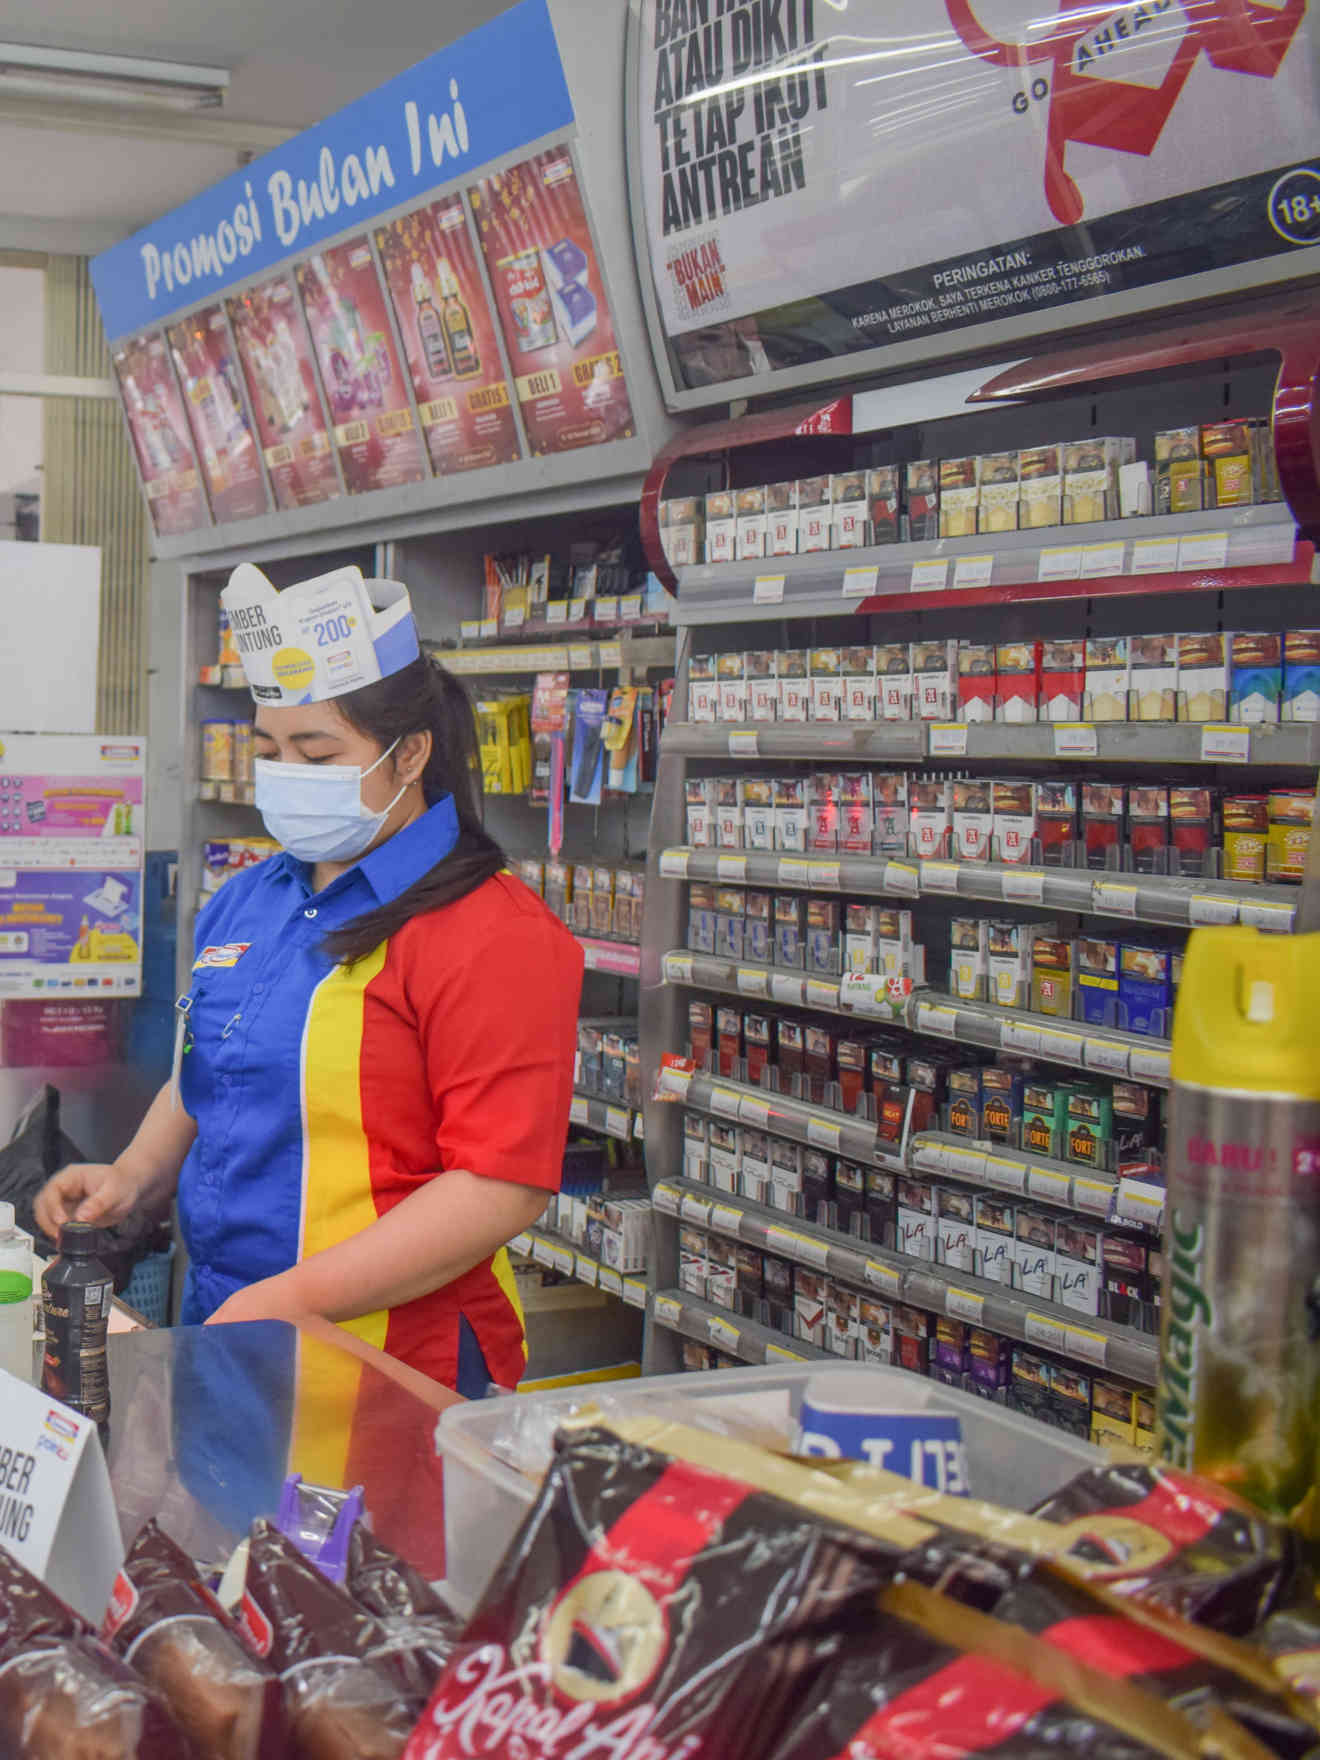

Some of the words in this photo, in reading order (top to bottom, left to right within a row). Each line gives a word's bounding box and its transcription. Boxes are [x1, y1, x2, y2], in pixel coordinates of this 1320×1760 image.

[655, 20, 723, 112] ATAU
[1012, 77, 1049, 114] GO
[654, 78, 746, 172] TETAP
[752, 44, 828, 136] IKUT
[140, 180, 262, 300] Promosi
[267, 145, 396, 247] Bulan
[404, 77, 470, 176] Ini
[662, 122, 806, 236] ANTREAN
[851, 312, 888, 329] KARENA
[938, 293, 965, 308] SAYA
[965, 280, 1012, 301] TERKENA
[1013, 268, 1056, 290] KANKER
[932, 251, 1033, 289] PERINGATAN:
[887, 314, 930, 334] LAYANAN
[931, 303, 979, 324] BERHENTI
[980, 288, 1031, 312] MEROKOK
[313, 615, 352, 647] 200
